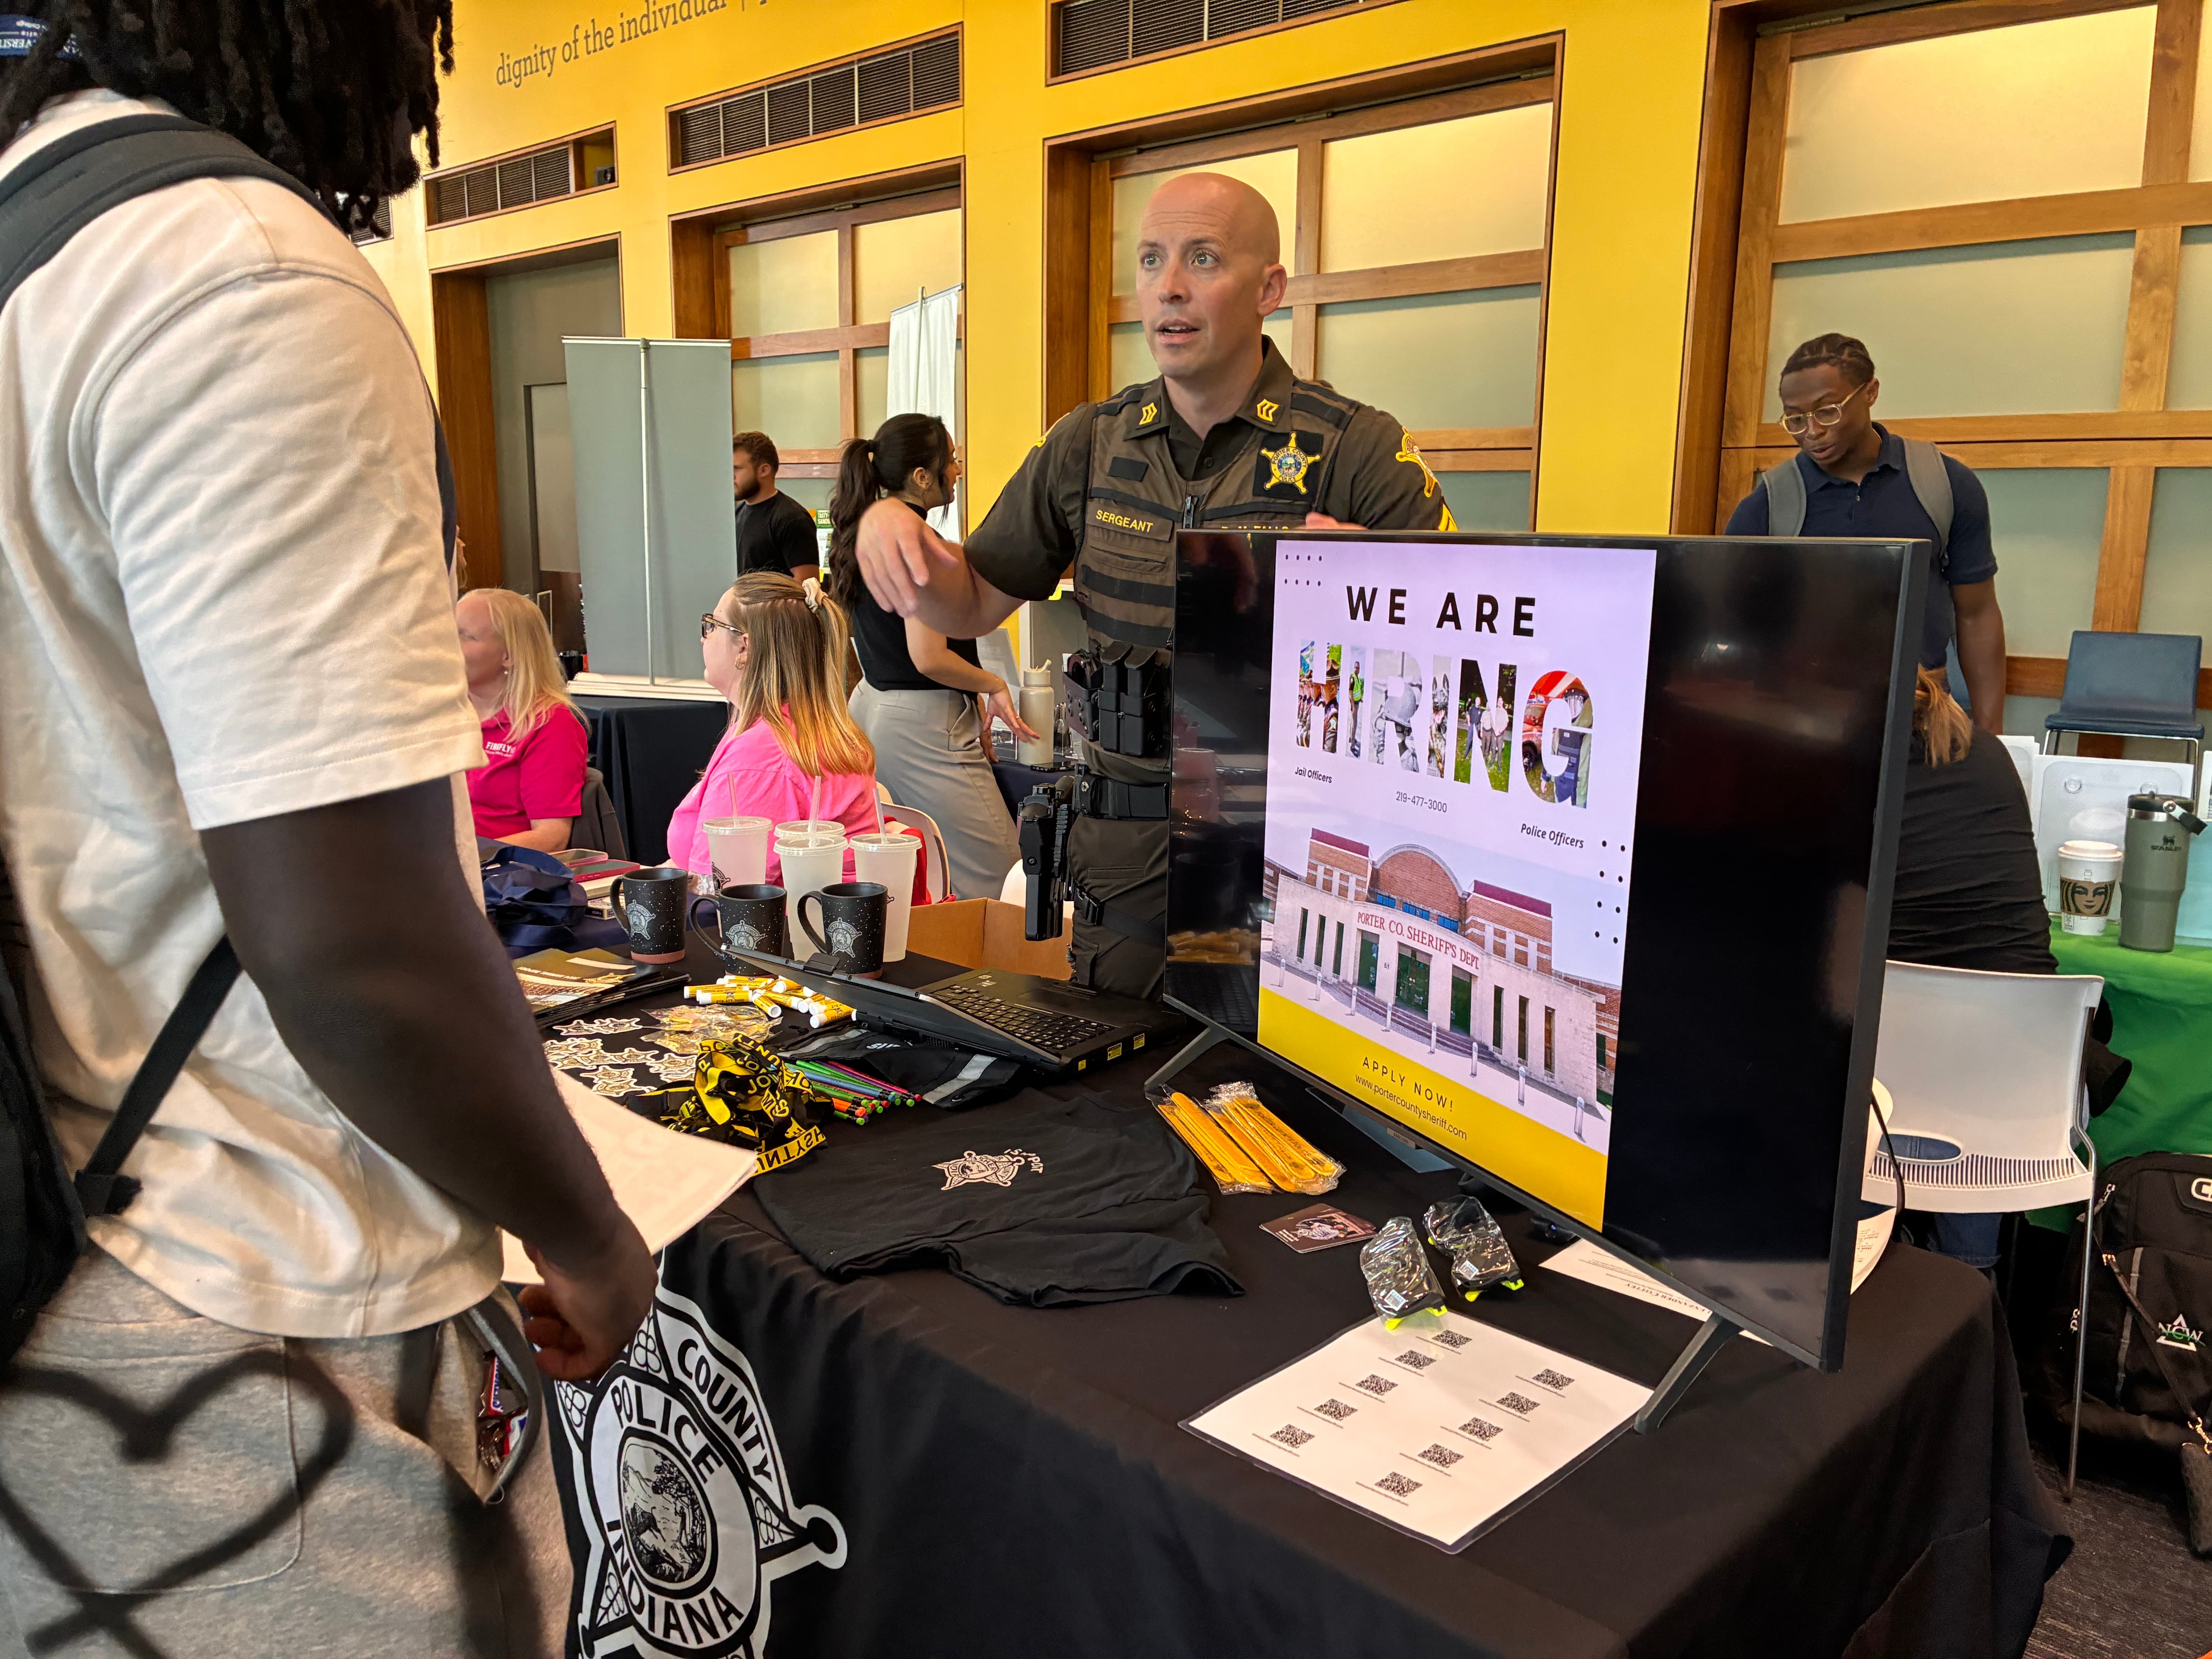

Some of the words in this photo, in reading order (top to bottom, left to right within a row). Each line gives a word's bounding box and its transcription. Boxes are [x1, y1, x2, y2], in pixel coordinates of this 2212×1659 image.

[496, 44, 557, 88] dignity
[561, 25, 580, 62] of
[584, 18, 615, 55] the
[1272, 447, 1290, 465] PORTER
[1292, 449, 1307, 468] COUNTY
[1096, 510, 1154, 533] SERGEANT
[1346, 585, 1407, 625] WE
[1436, 591, 1536, 637] ARE
[1296, 639, 1594, 810] HIRING
[1295, 766, 1305, 777] Jail
[1307, 769, 1333, 783] Officers
[1396, 790, 1447, 813] 219-477-3000
[1520, 823, 1547, 840] Police
[1548, 829, 1584, 849] Officers
[1357, 912, 1385, 930] PORTER
[1389, 920, 1404, 937] CO.
[1407, 926, 1457, 958] SHERIFF'S
[1355, 1074, 1468, 1141] www.portercountysheriff.com
[1362, 1056, 1406, 1086] APPLY
[1414, 1082, 1453, 1113] NOW!
[2158, 1322, 2203, 1342] NCW
[611, 1377, 723, 1485] POLICE
[677, 1338, 776, 1483] COUNTY
[606, 1519, 744, 1644] INDIANA
